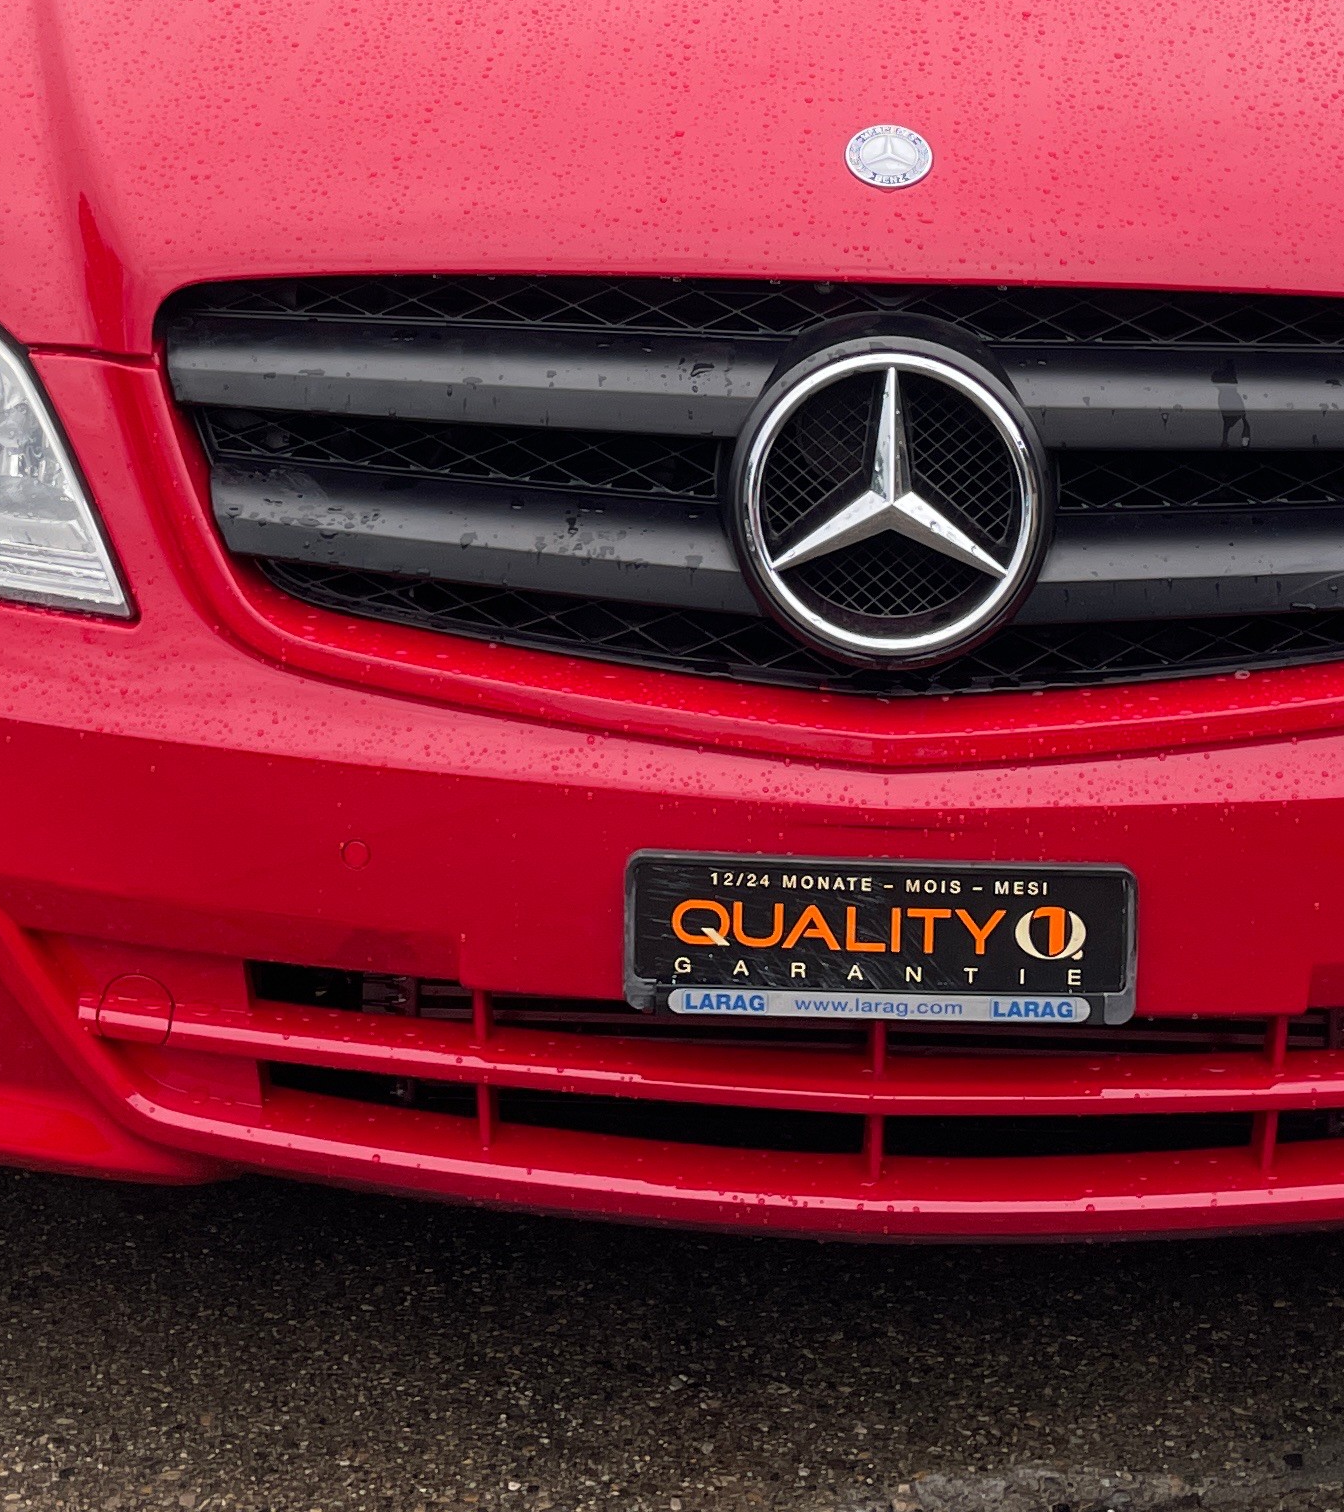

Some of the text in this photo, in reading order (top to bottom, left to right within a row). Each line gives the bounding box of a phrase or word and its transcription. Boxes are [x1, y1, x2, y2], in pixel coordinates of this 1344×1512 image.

[710, 872, 1048, 896] 12/24 MONATE MOIS MESI
[671, 899, 1007, 956] QUALITY
[674, 956, 1082, 986] GARANTIE
[684, 992, 1074, 1019] LARAG www.larag.com LARAG
